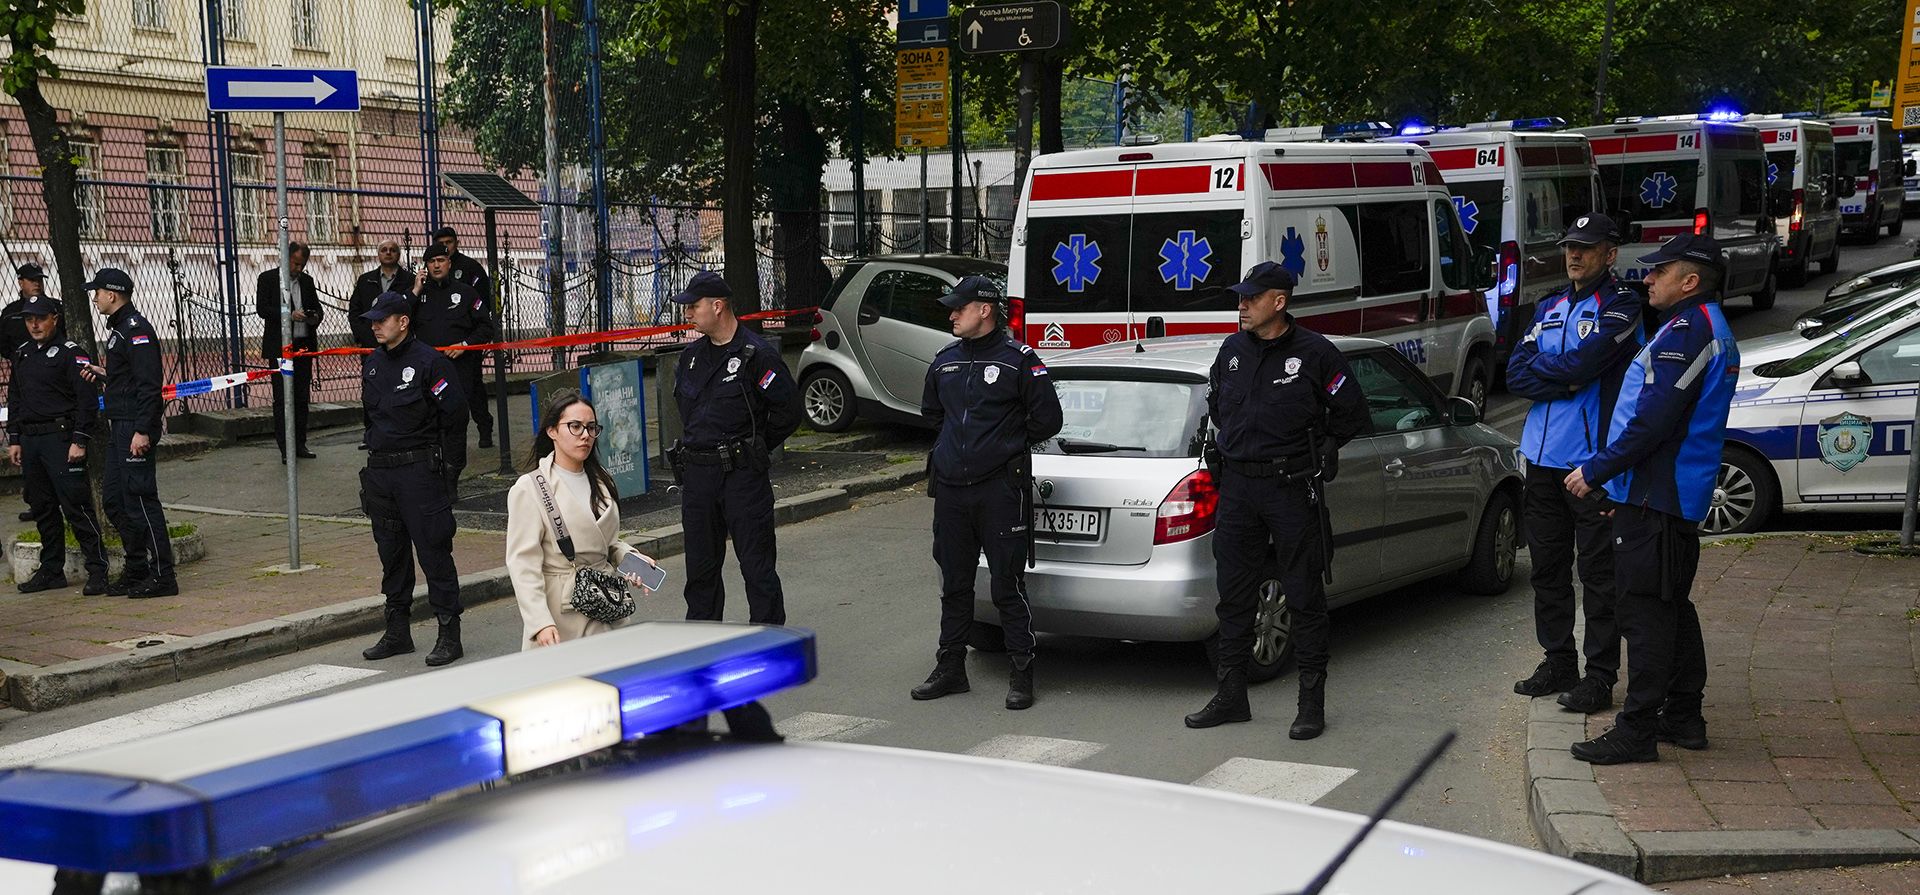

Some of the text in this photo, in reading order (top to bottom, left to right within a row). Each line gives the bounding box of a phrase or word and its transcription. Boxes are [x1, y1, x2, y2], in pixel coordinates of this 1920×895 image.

[901, 51, 944, 64] ЗОНА 2
[1778, 128, 1792, 141] 59
[1859, 126, 1870, 134] 41
[1679, 135, 1693, 148] 14
[1477, 149, 1497, 166] 64
[1214, 166, 1235, 189] 12
[1413, 161, 1422, 183] 12
[536, 474, 555, 512] Christian
[553, 515, 565, 539] Dior
